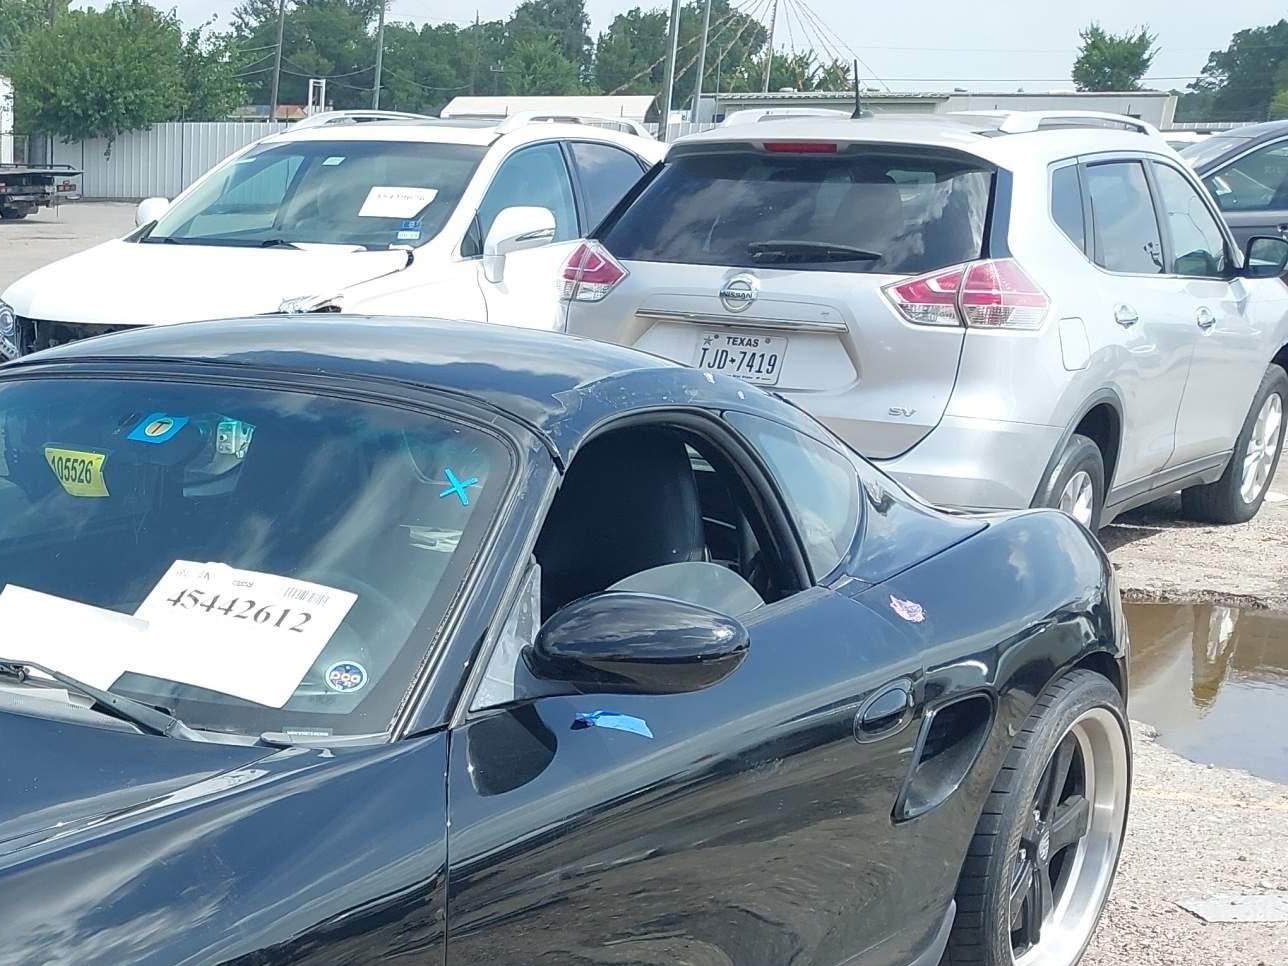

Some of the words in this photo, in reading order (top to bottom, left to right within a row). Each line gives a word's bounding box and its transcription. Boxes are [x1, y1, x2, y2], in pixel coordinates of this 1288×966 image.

[723, 291, 753, 299] NISSAN
[726, 336, 760, 348] TEXAS
[888, 407, 917, 417] SV
[166, 588, 312, 633] 45442612
